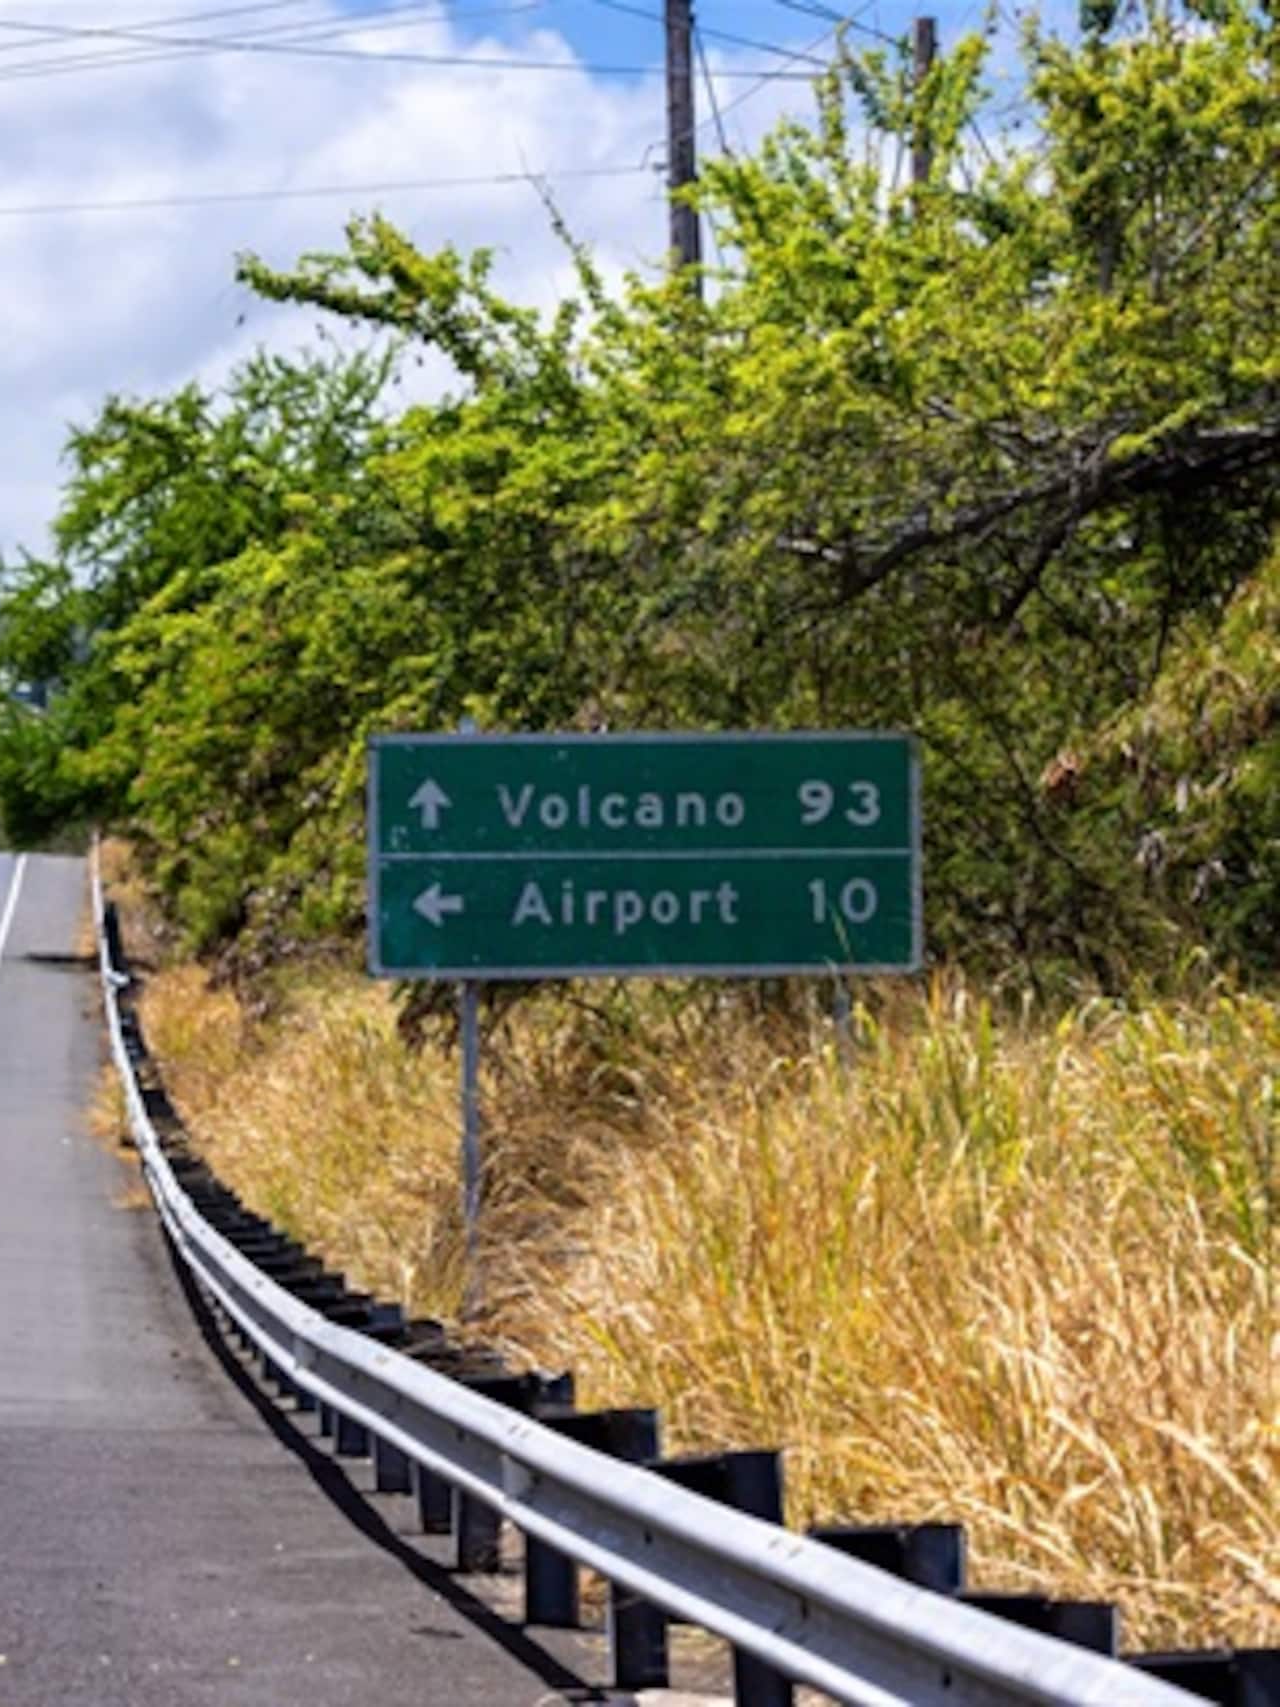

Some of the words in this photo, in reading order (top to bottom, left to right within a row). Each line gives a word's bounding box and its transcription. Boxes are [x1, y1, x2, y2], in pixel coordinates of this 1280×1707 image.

[496, 783, 746, 829] Volcano
[797, 780, 882, 827] 93
[512, 880, 740, 934] Airport
[808, 878, 878, 924] 10
